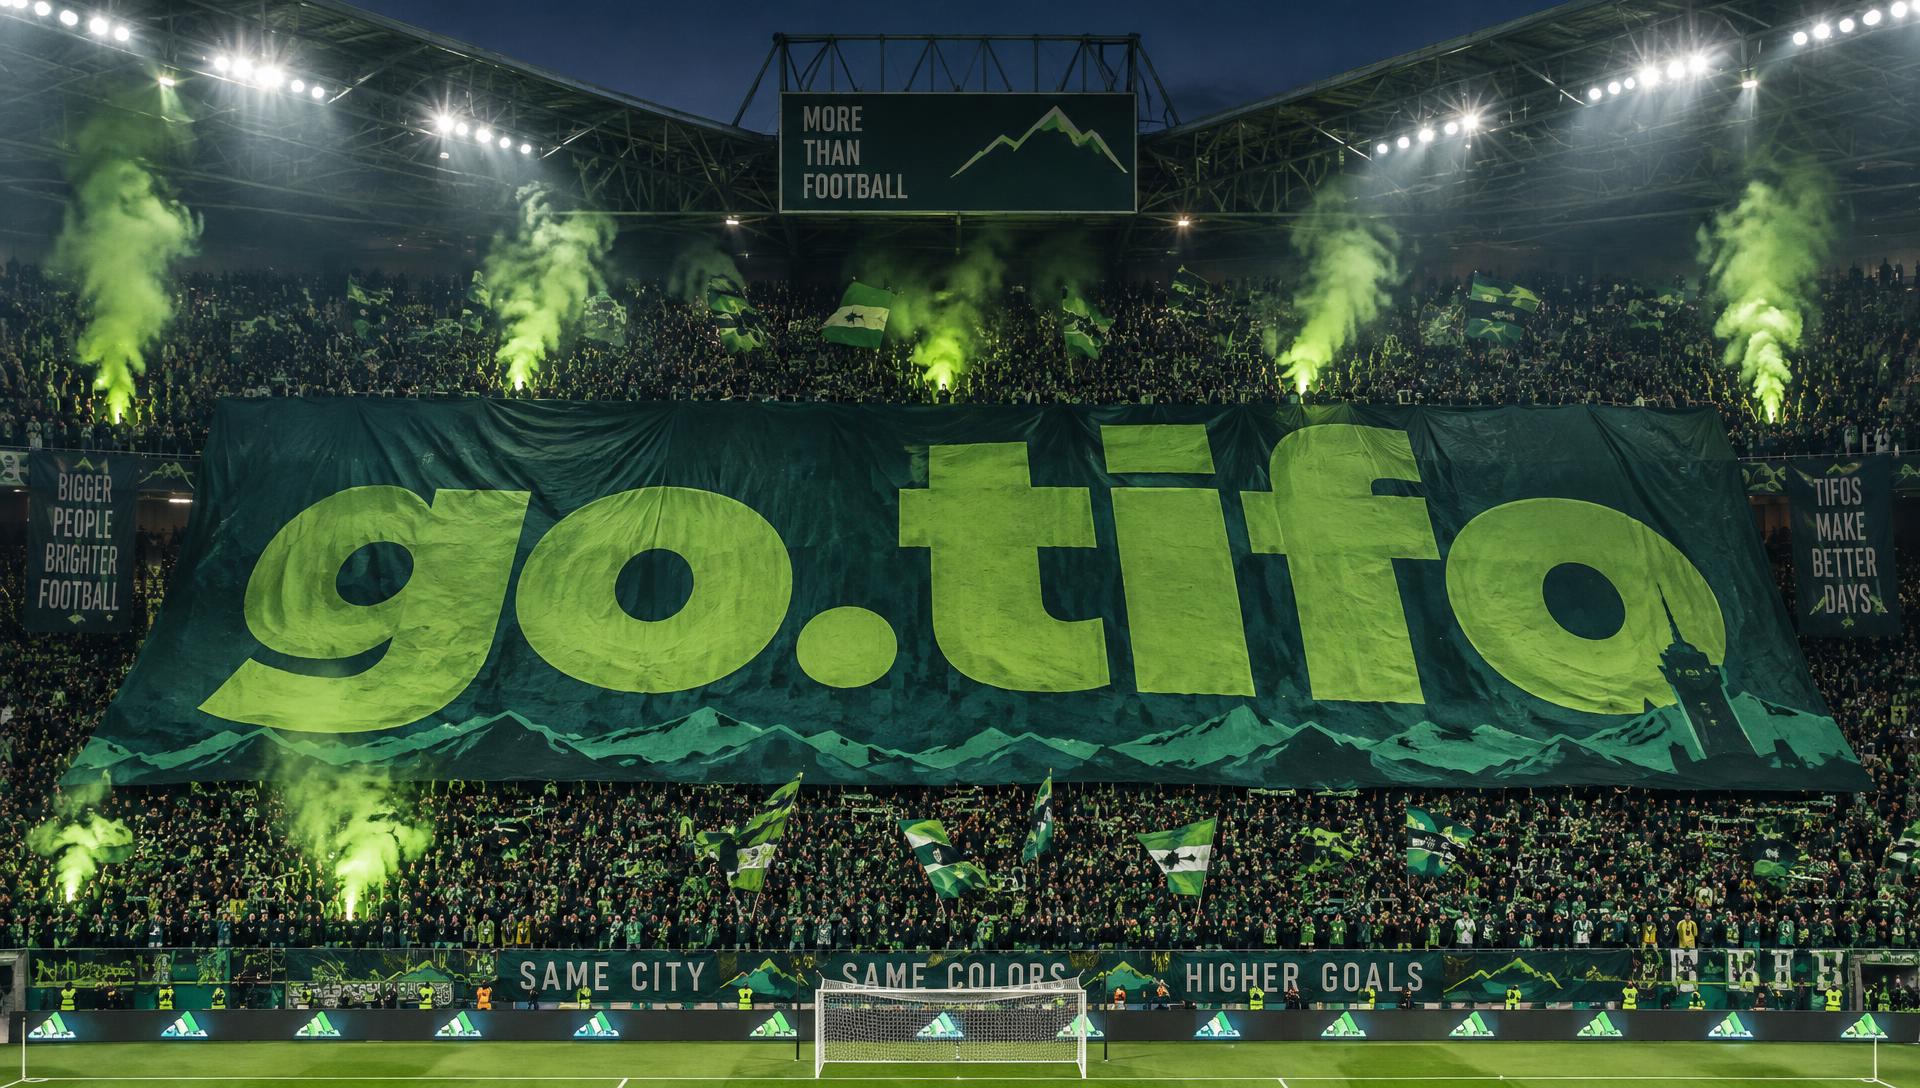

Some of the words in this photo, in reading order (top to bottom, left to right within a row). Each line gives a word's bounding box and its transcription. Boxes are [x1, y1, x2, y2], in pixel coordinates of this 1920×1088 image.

[803, 105, 863, 132] MORE
[803, 139, 860, 166] THAN
[803, 173, 908, 199] FOOTBALL
[58, 472, 112, 503] BIGGER
[1813, 477, 1863, 506] TIFOS
[53, 507, 114, 539] PEOPLE
[1815, 511, 1867, 542] MAKE
[45, 543, 118, 575] BRIGHTER
[1811, 547, 1878, 578] BETTER
[195, 424, 1727, 733] go.tifo
[38, 579, 119, 611] FOOTBALL
[1824, 583, 1873, 614] DAYS
[520, 960, 610, 992] SAME
[631, 961, 706, 992] CITY
[842, 962, 928, 990] SAME
[1186, 962, 1300, 993] HIGHER
[1321, 962, 1424, 993] GOALS
